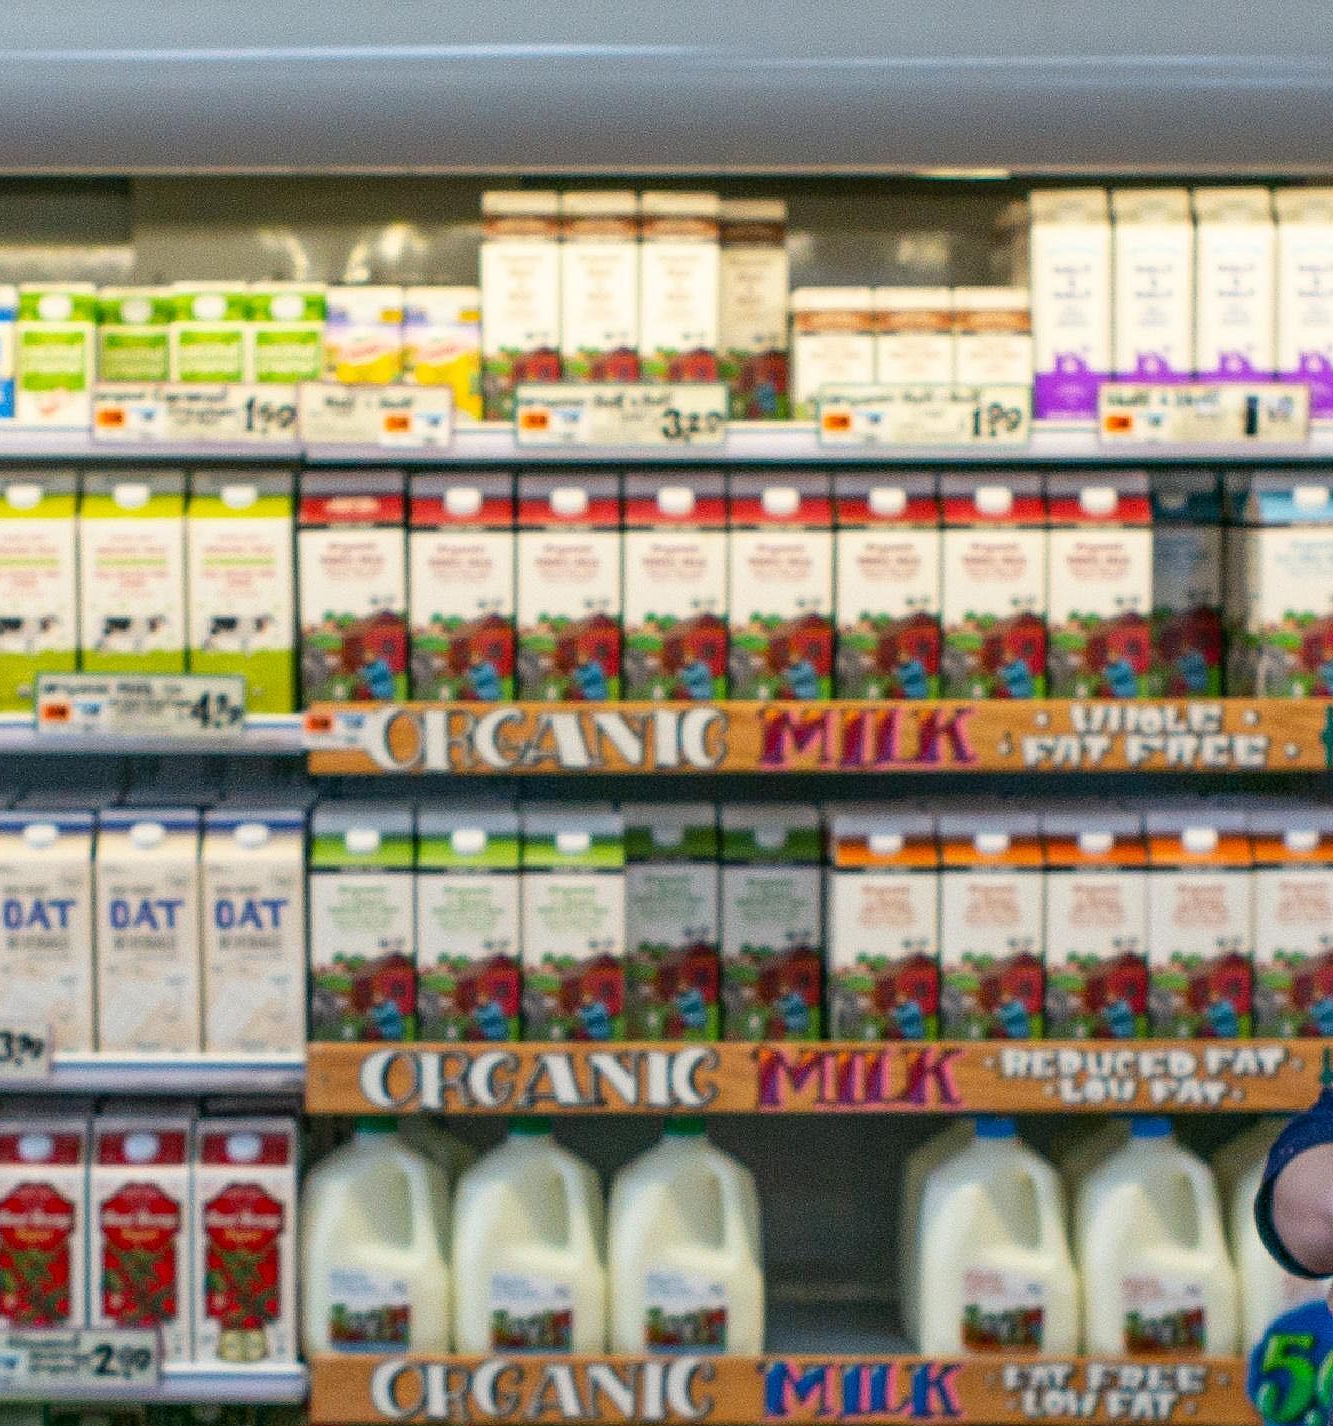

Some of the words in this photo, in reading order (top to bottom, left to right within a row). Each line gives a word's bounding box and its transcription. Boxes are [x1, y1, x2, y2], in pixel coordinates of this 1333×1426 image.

[758, 705, 976, 769] MILK
[1021, 735, 1112, 769] FAT
[2, 898, 77, 931] OAT
[109, 899, 185, 931] OAT
[214, 899, 289, 931] OAT
[1001, 1047, 1199, 1078] REDUCED
[1205, 1046, 1287, 1076] FAT
[360, 1048, 720, 1111] ORGANIC
[755, 1047, 968, 1111] MILK
[1150, 1078, 1228, 1106] FAT
[369, 1360, 717, 1423] ORGANIC
[759, 1360, 963, 1421] MILK
[1002, 1363, 1073, 1392] FAT
[1086, 1362, 1207, 1393] FREE
[1022, 1388, 1099, 1419] LOW
[1106, 1390, 1178, 1421] FAT
